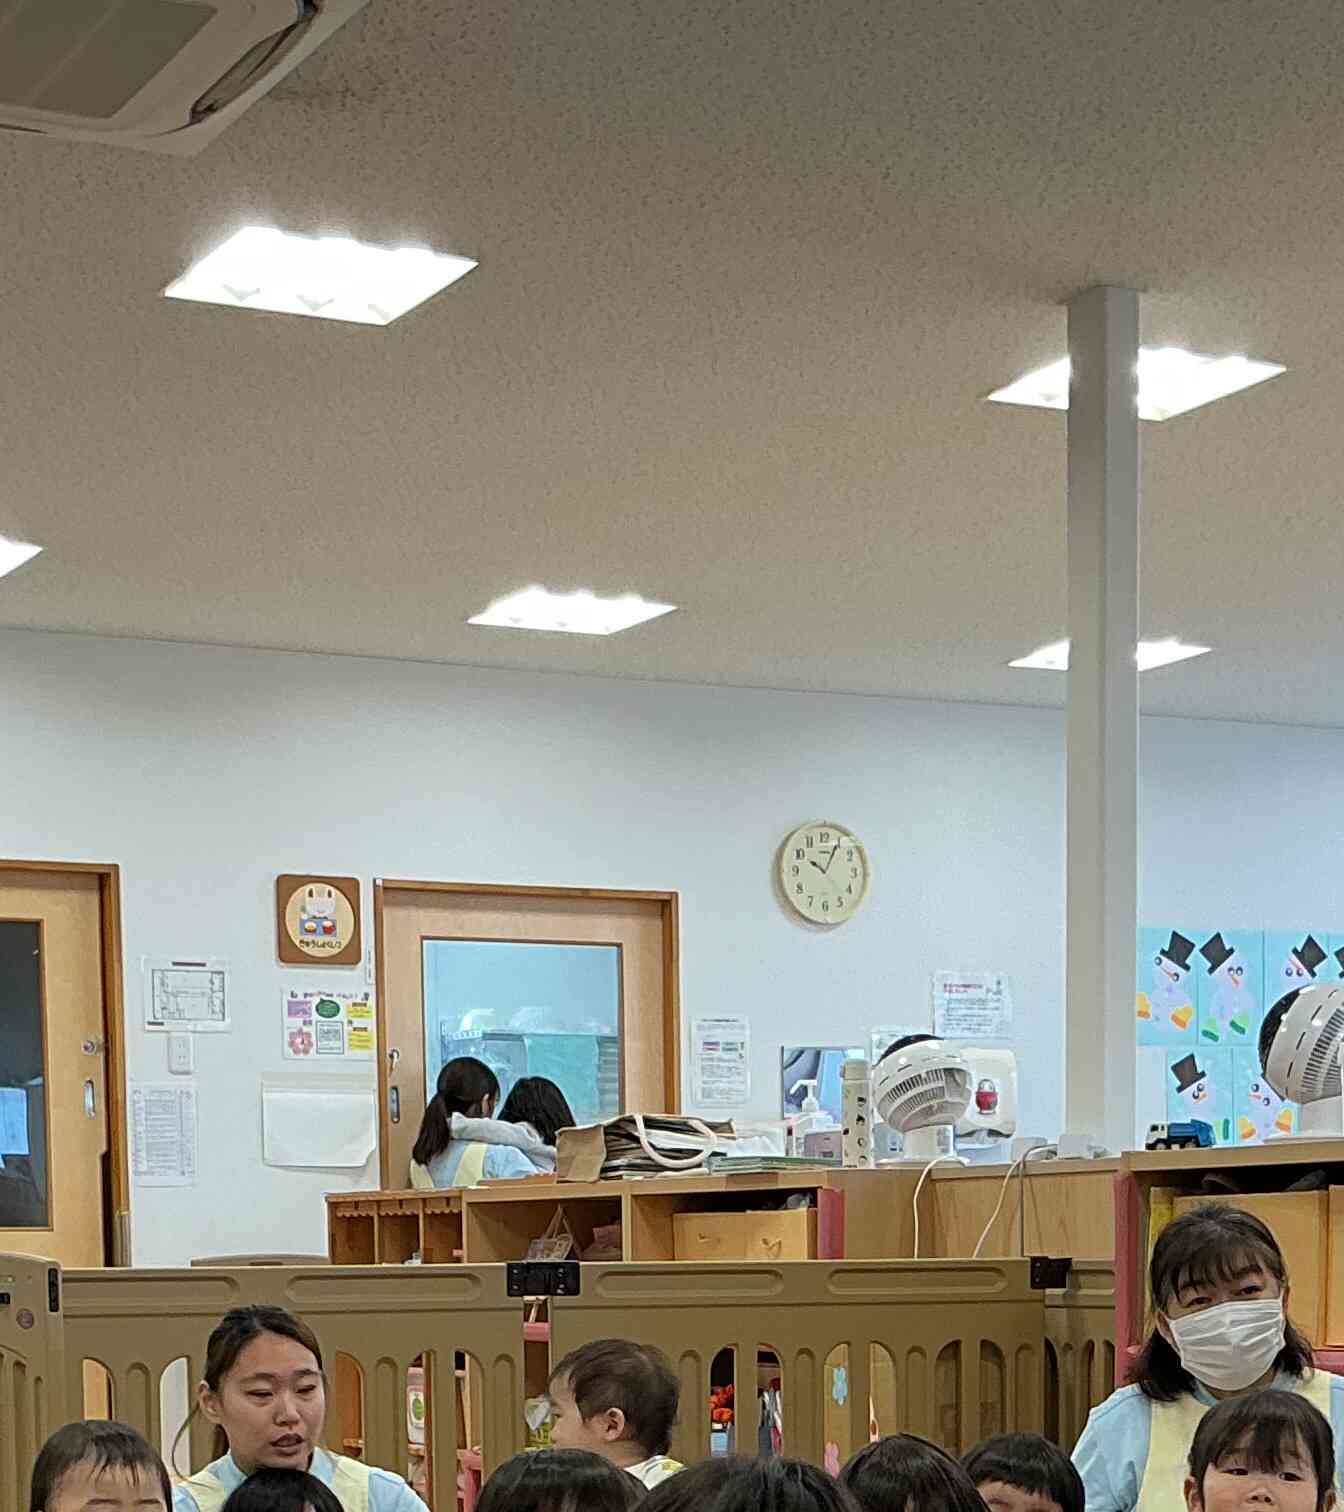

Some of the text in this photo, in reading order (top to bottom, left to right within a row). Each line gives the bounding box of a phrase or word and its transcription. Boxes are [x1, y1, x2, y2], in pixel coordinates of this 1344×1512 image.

[806, 836, 814, 848] 11
[819, 832, 830, 844] 12
[796, 848, 805, 860] 10
[847, 848, 854, 862] 2
[792, 865, 800, 877] 9
[851, 868, 858, 879] 3
[796, 882, 804, 894] 8
[845, 883, 852, 895] 4
[808, 896, 814, 907] 7
[822, 901, 829, 912] 6
[836, 896, 844, 908] 5
